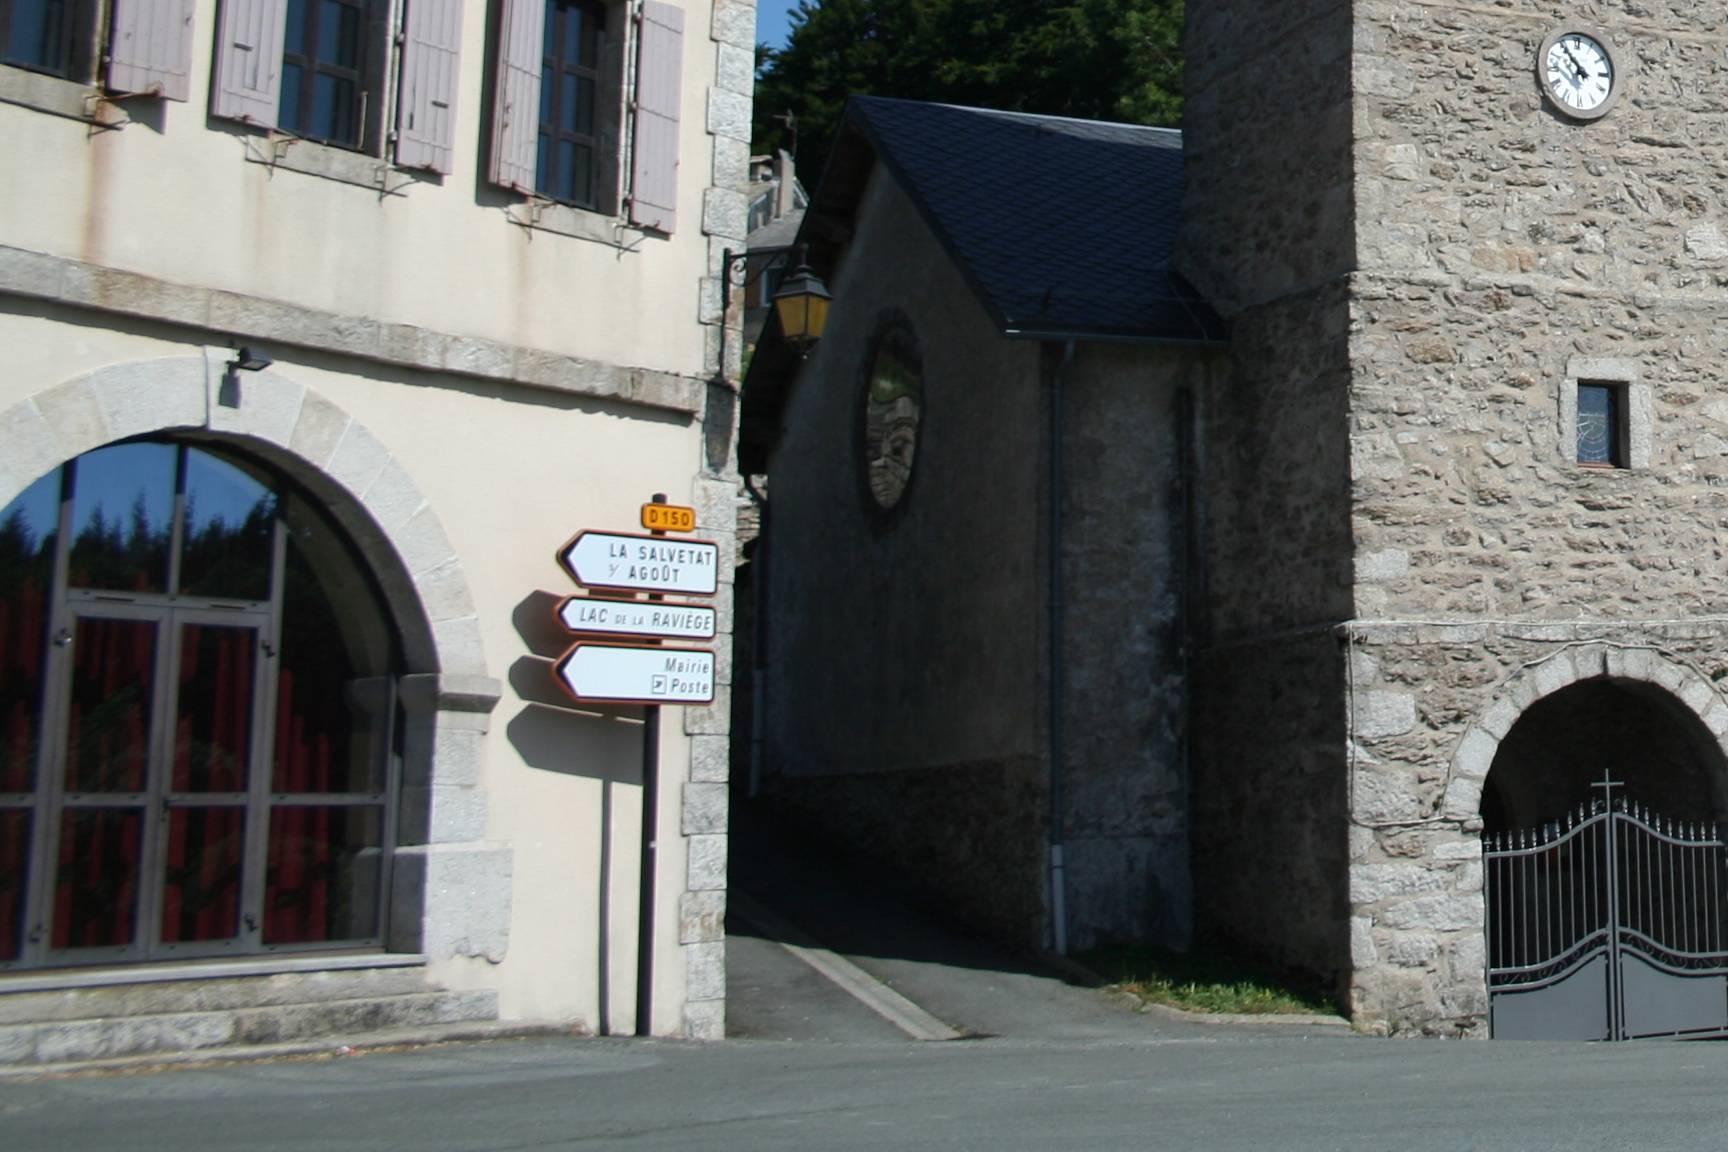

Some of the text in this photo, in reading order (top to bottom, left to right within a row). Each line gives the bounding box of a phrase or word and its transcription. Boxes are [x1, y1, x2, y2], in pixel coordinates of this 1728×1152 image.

[609, 542, 713, 566] LA SALVETAT
[628, 564, 680, 583] AGOÛT
[579, 606, 608, 623] LAC
[632, 615, 645, 626] LA
[651, 609, 711, 631] RAVIÈGE
[664, 657, 710, 674] Mairie
[670, 677, 710, 694] Poste
